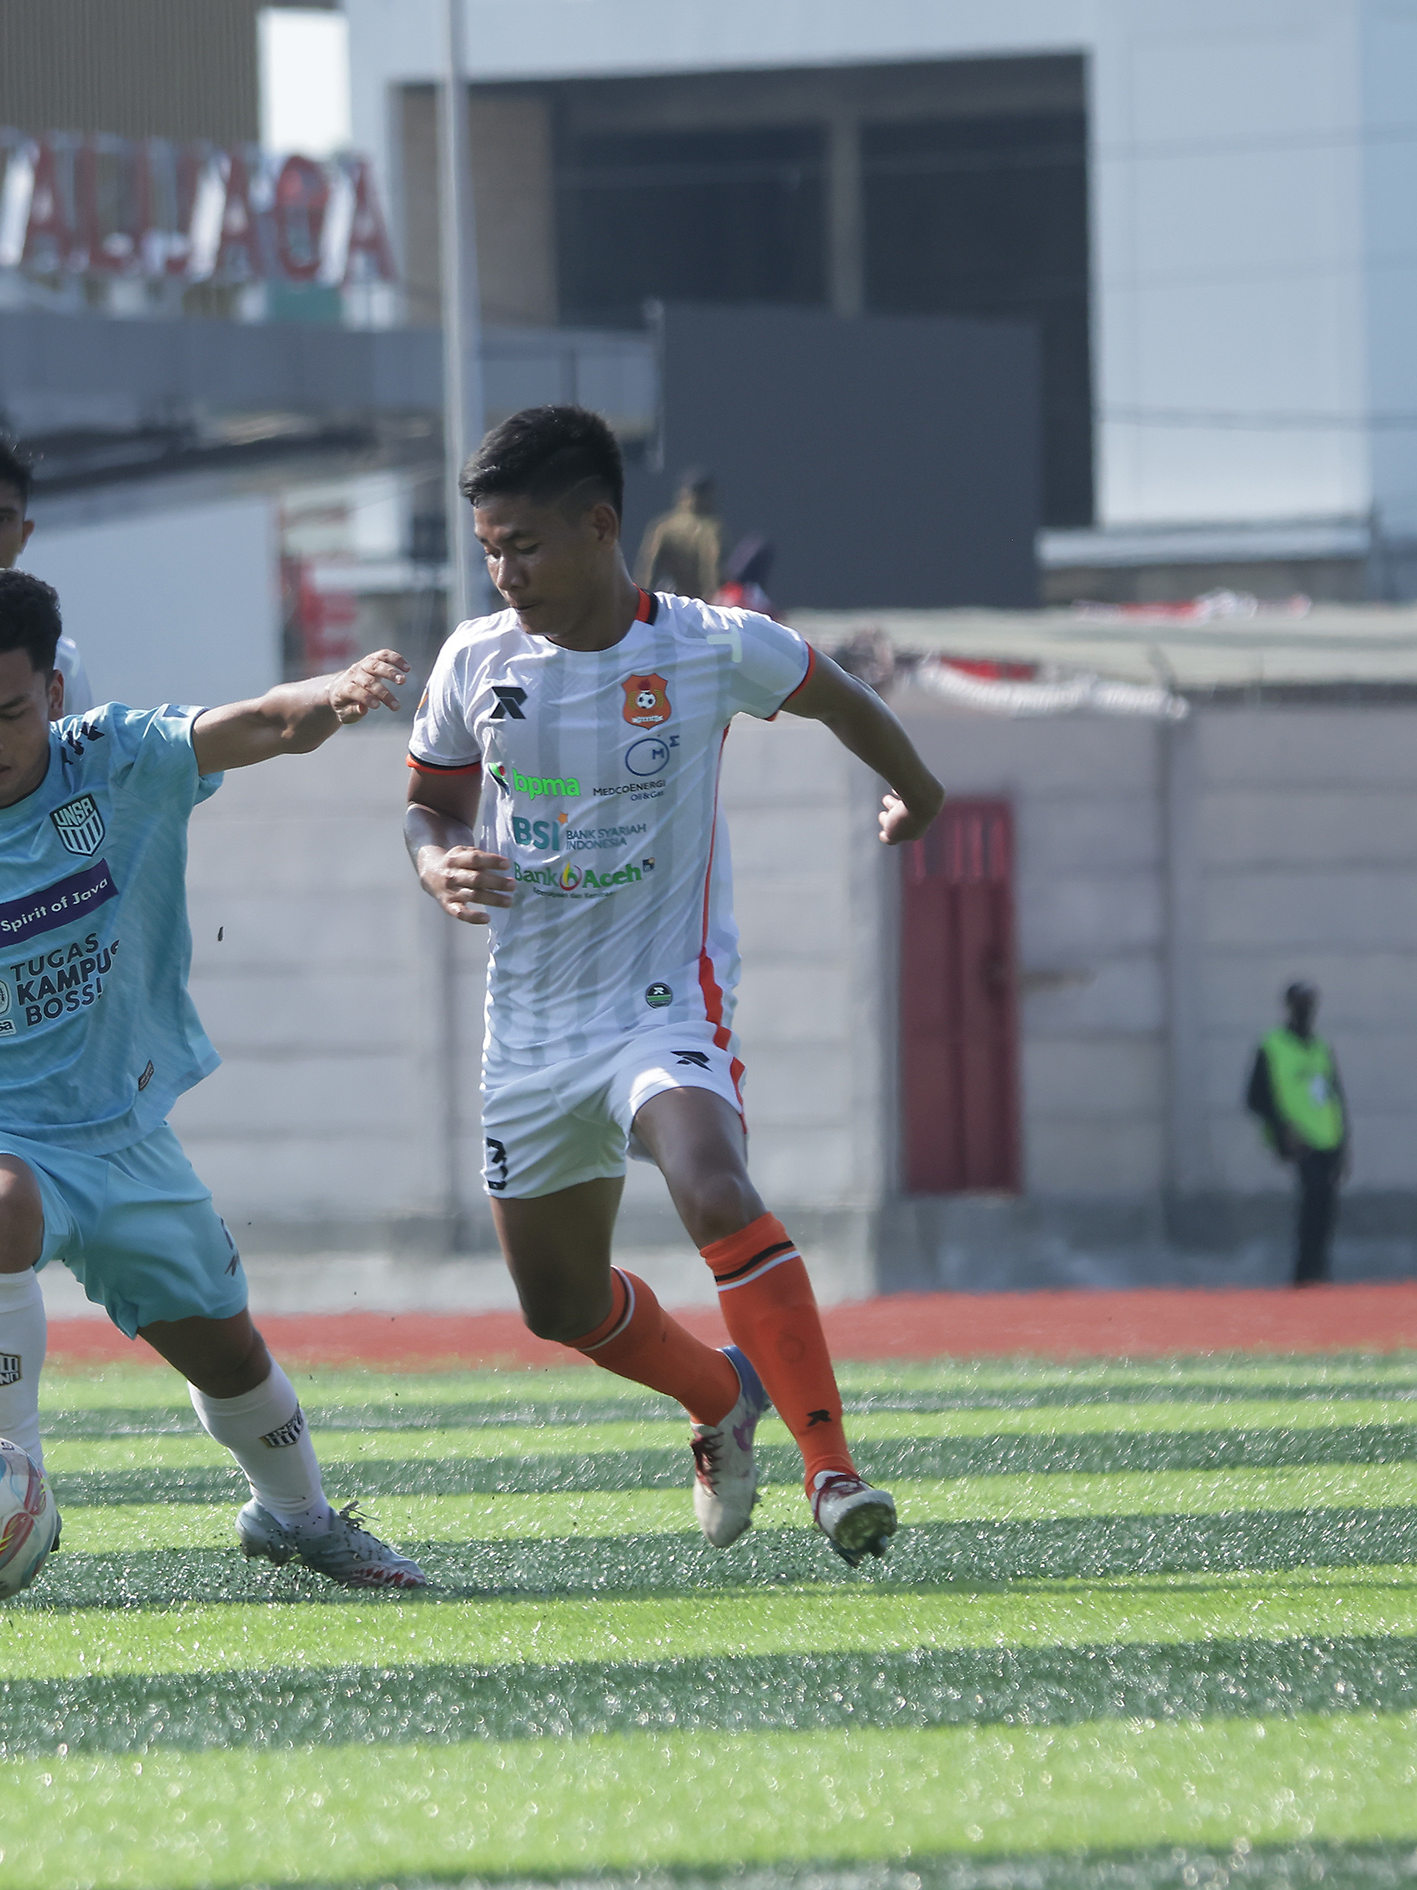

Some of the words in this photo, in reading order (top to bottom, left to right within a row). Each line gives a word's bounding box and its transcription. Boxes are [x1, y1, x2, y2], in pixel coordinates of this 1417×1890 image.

[512, 768, 581, 800] bpma
[54, 797, 93, 826] UNSA
[512, 817, 560, 851] BSI
[566, 829, 595, 840] BANK
[598, 823, 646, 839] SYARIAH
[566, 837, 627, 850] INDONESIA
[513, 862, 559, 886] Bank
[582, 864, 642, 889] Aceh
[1, 905, 47, 932] Spirit
[51, 896, 68, 912] of
[72, 878, 108, 905] Java
[10, 932, 99, 981] TUGAS
